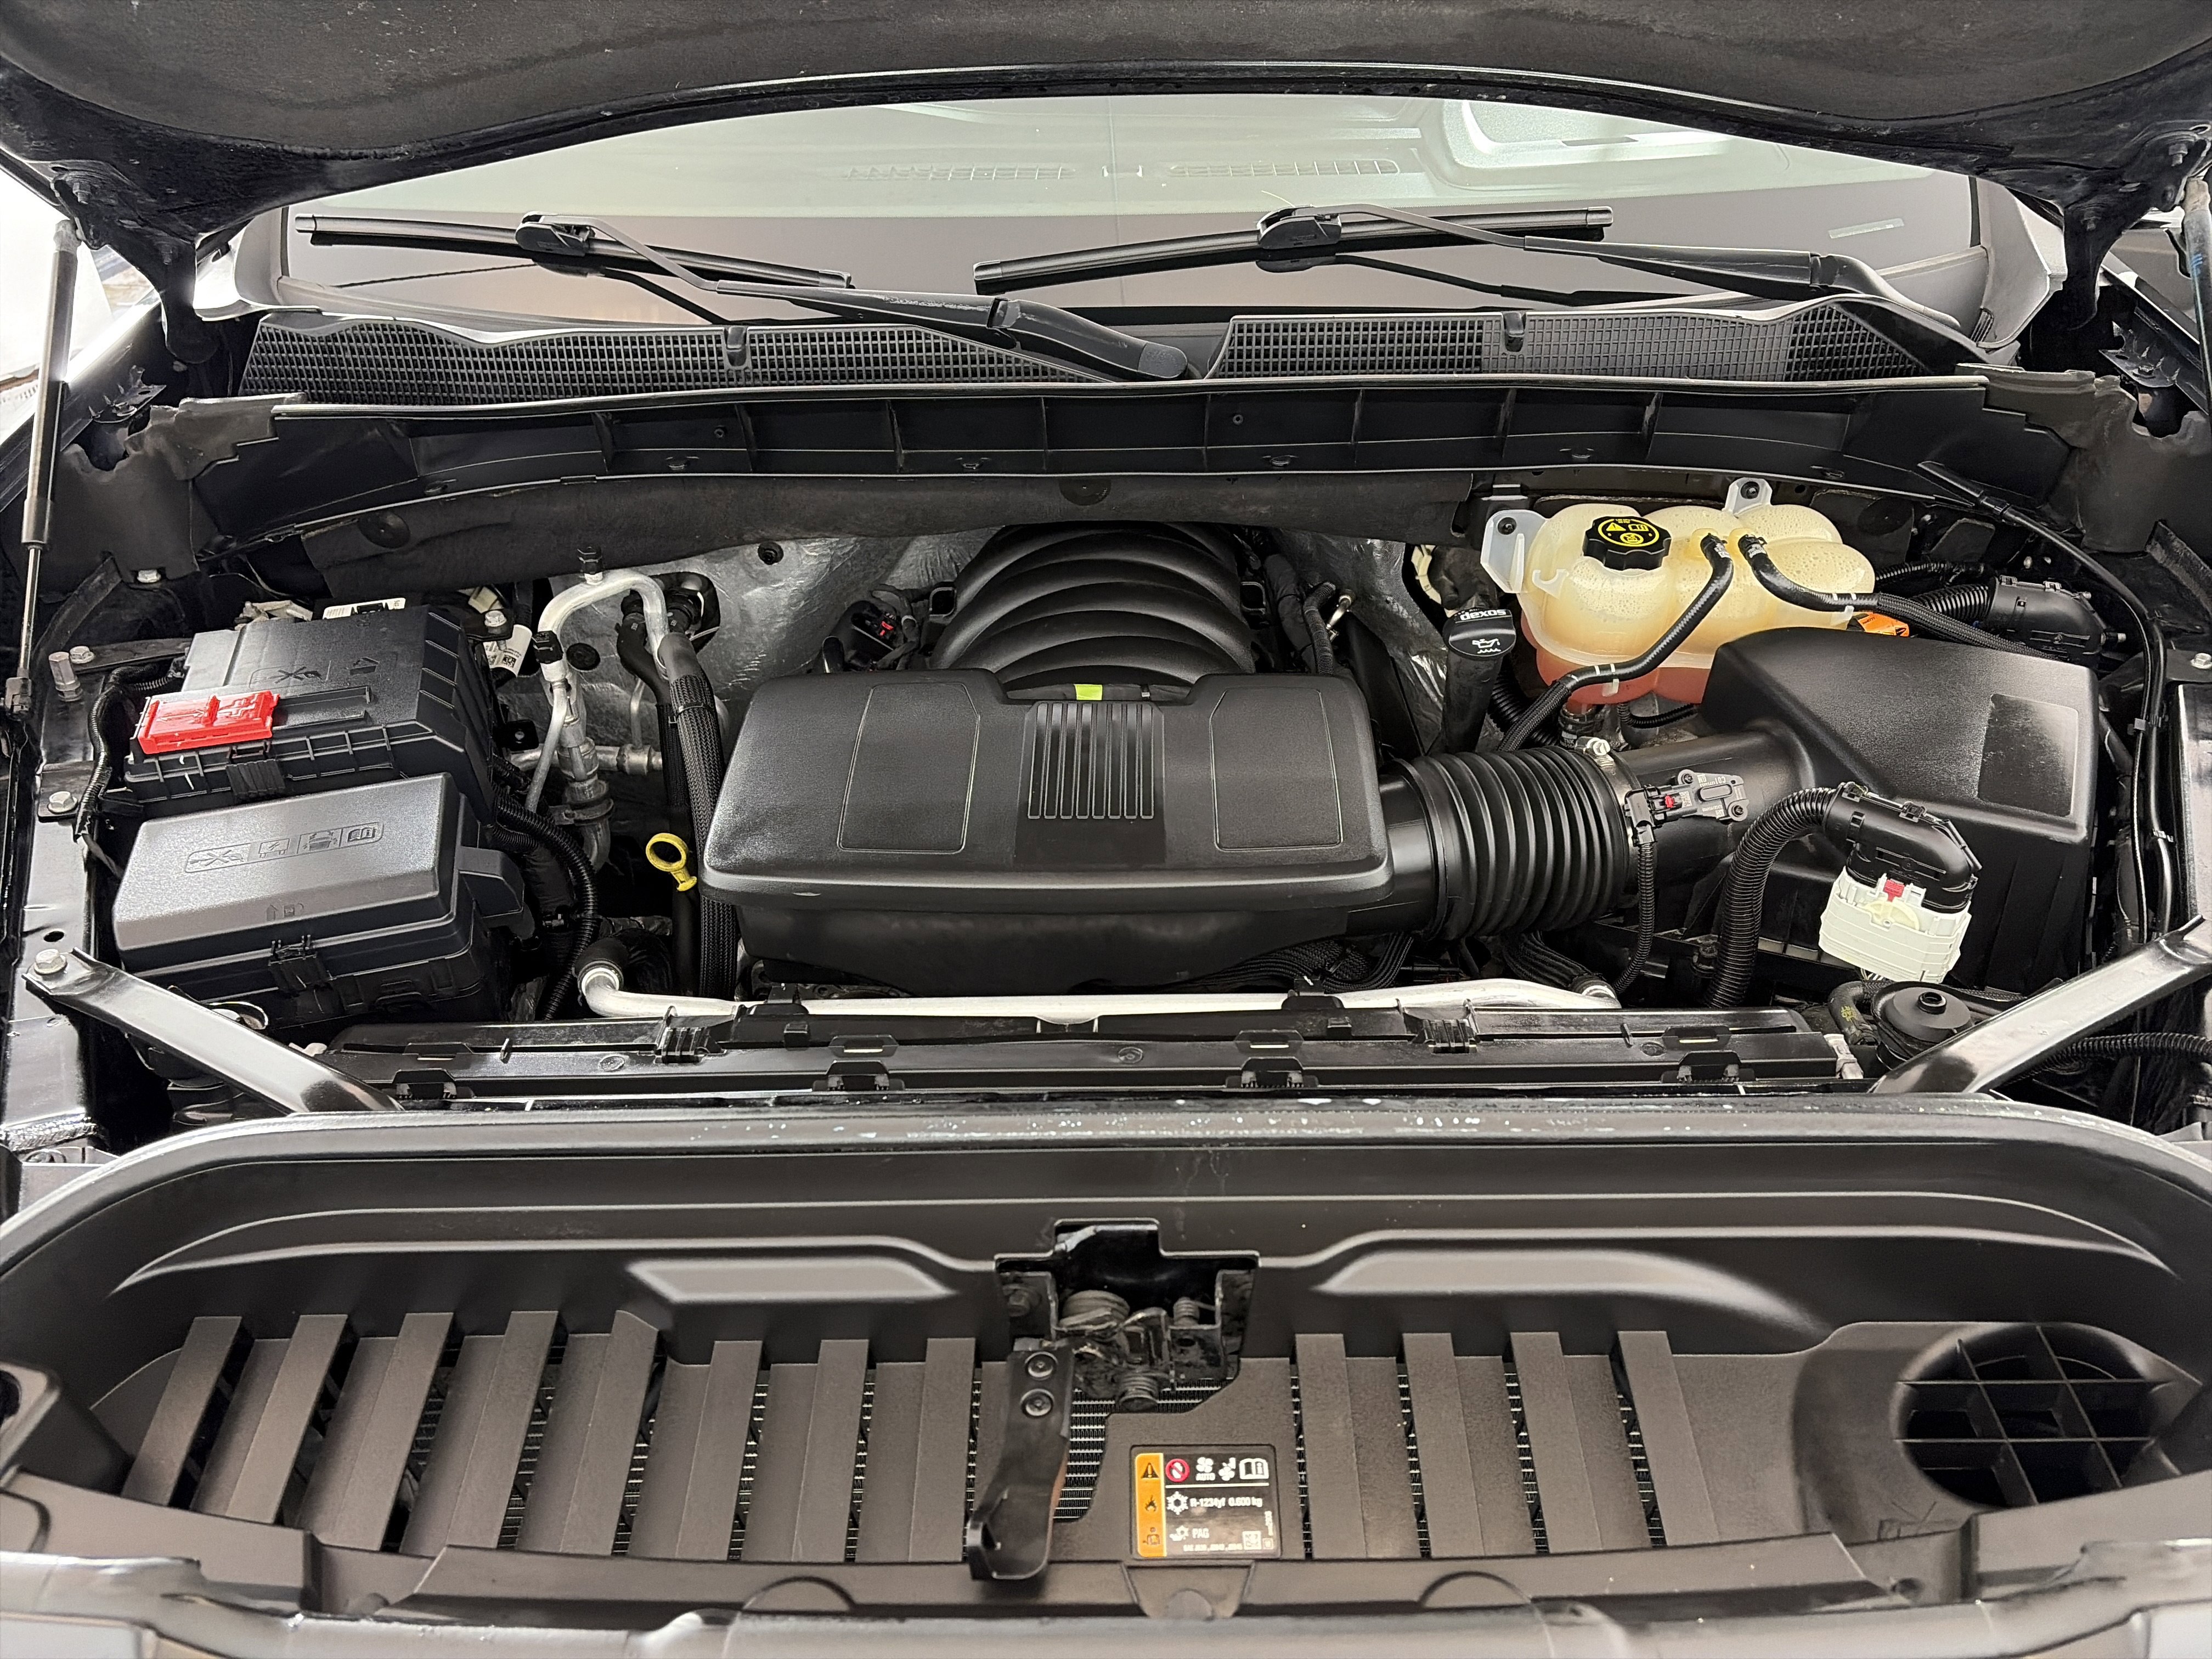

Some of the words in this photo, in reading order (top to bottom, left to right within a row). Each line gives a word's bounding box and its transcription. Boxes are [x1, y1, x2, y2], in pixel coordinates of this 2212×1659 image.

[1460, 610, 1506, 620] dexos
[1697, 776, 1707, 784] GM
[1196, 1472, 1216, 1481] AUTO
[1189, 1497, 1226, 1509] R-1234yf
[1251, 1497, 1263, 1508] kg
[1192, 1528, 1210, 1538] PAG
